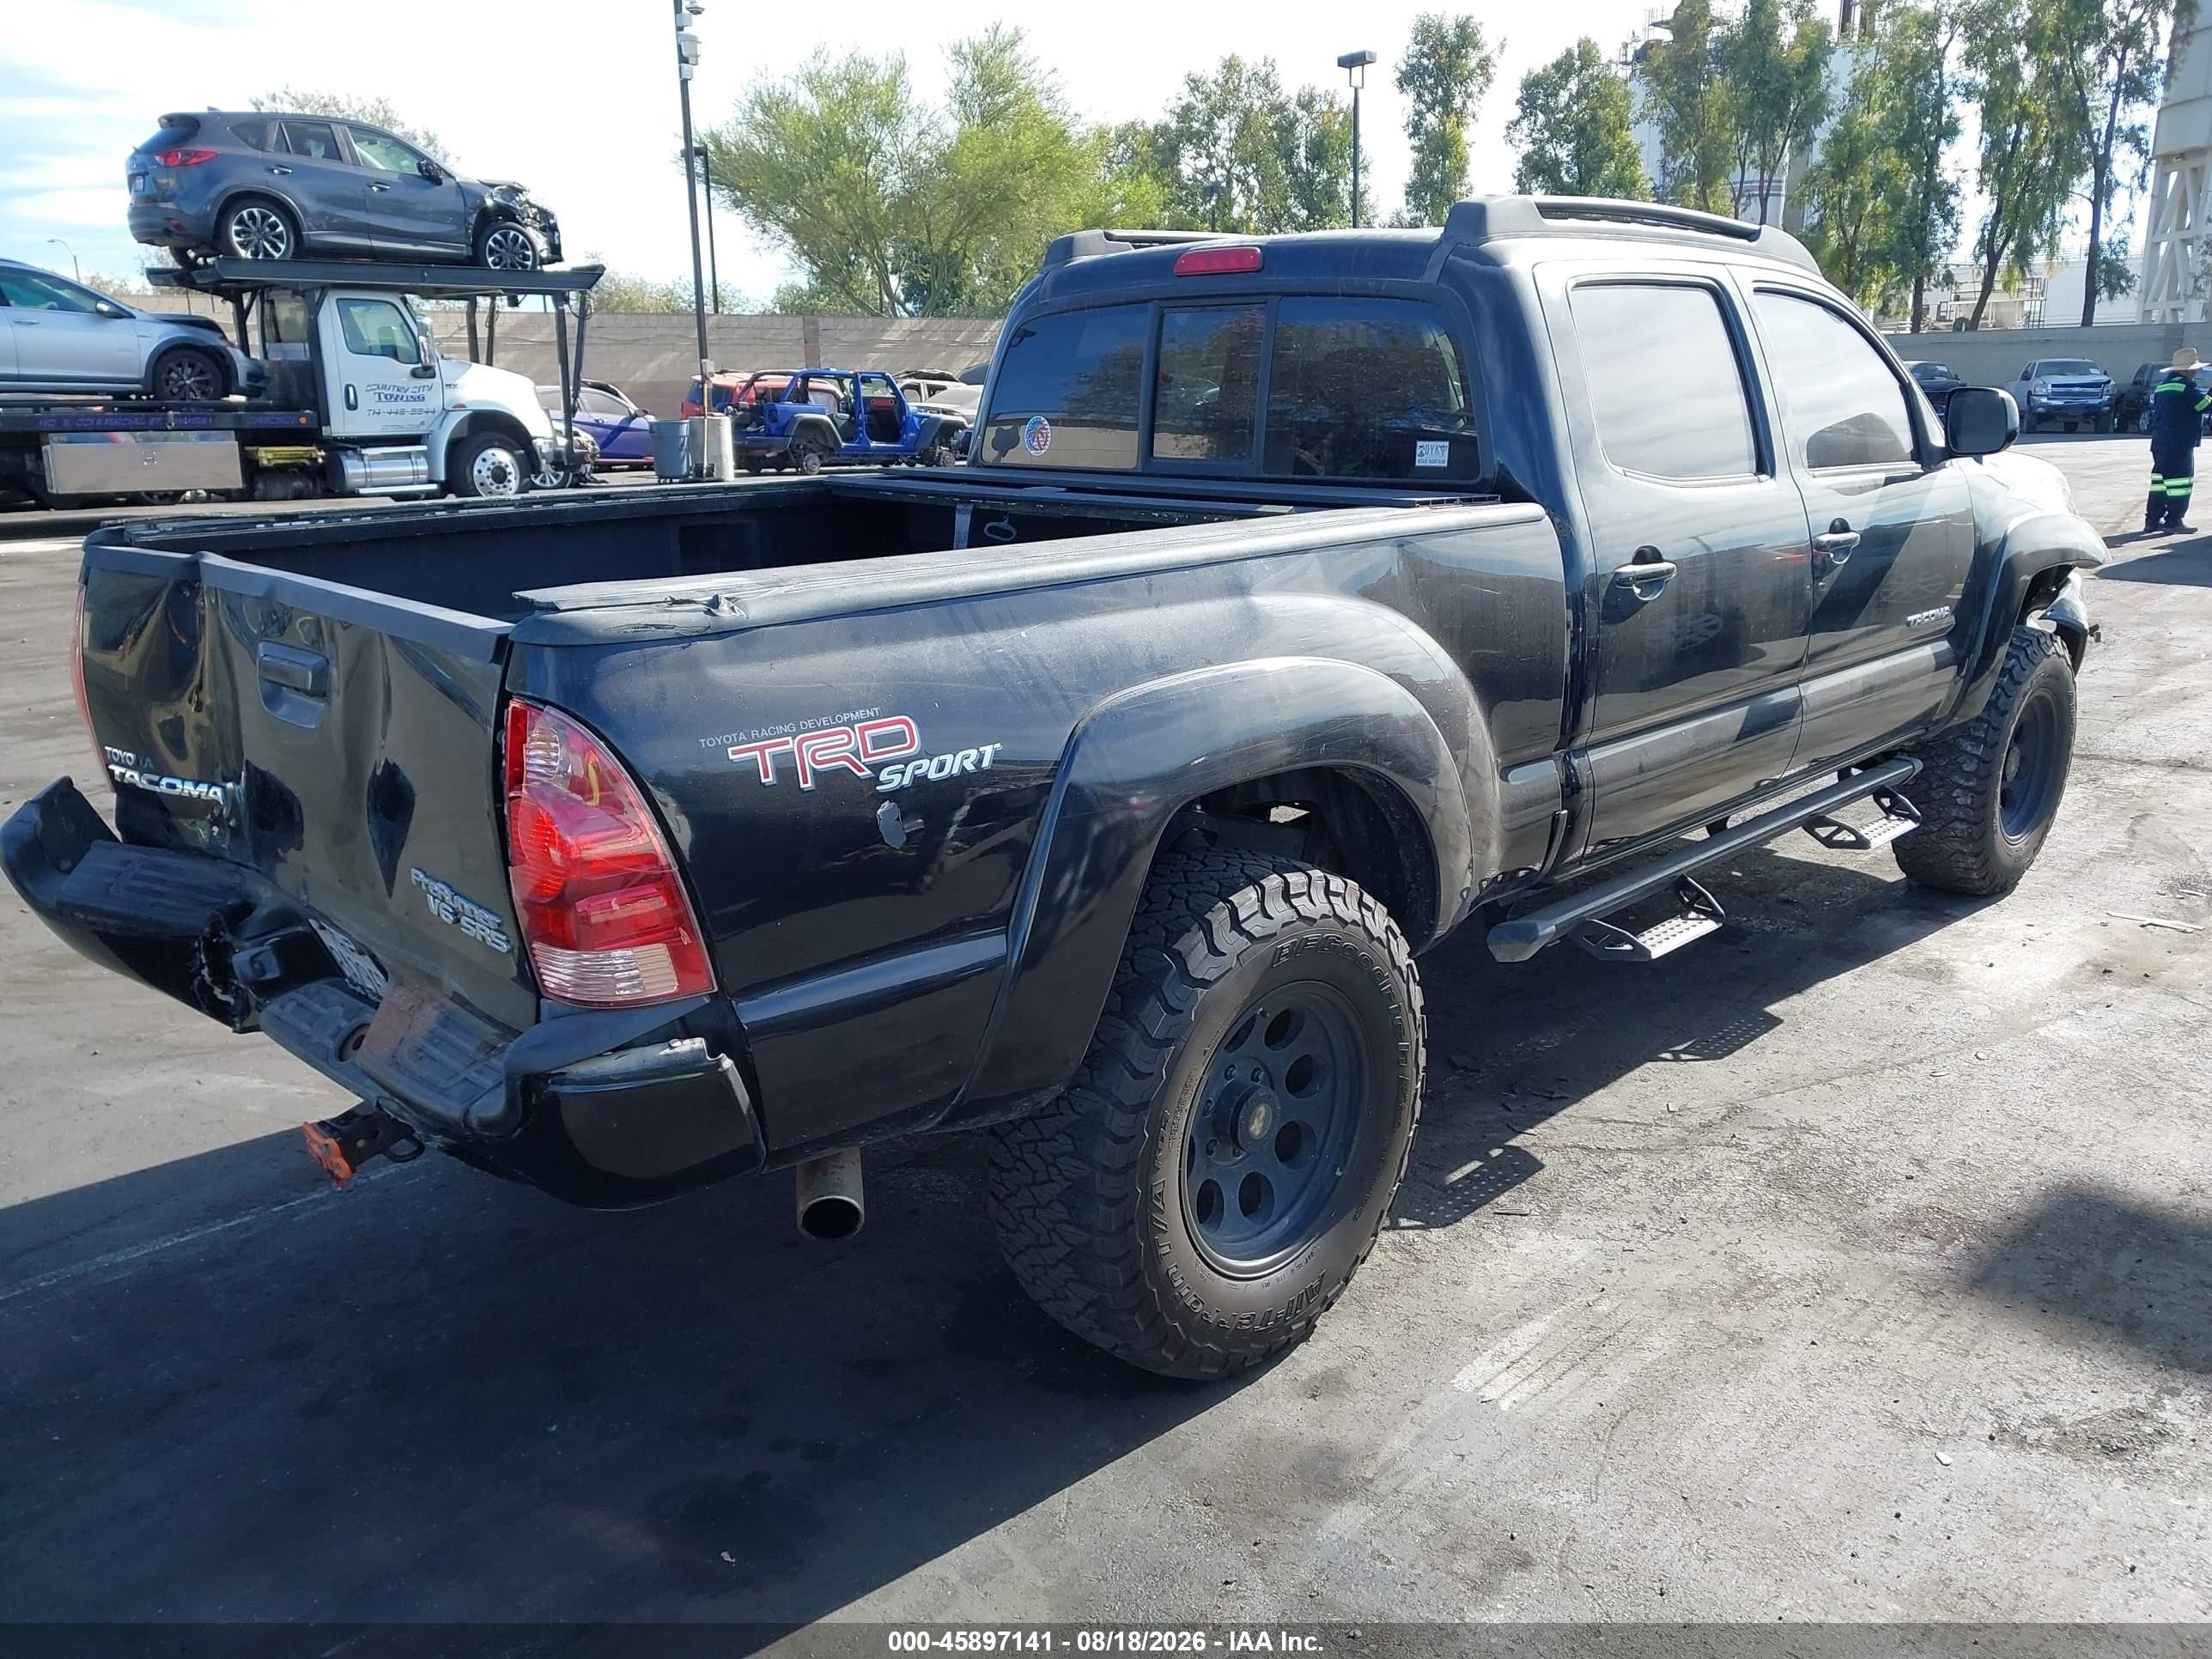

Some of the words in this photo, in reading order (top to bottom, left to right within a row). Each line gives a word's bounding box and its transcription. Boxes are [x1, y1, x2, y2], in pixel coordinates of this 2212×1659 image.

[365, 383, 410, 393] COUNTRY
[411, 383, 434, 393] CITY
[374, 392, 426, 402] TOWING
[1905, 605, 1951, 626] TACOMA
[699, 731, 747, 749] TOYOTA
[751, 723, 797, 738] RACING
[799, 707, 881, 731] DEVELOPMENT
[727, 714, 921, 792] TRD
[876, 742, 1003, 793] SPORT
[107, 763, 224, 805] TACOMA
[426, 893, 454, 925] V6
[1273, 933, 1411, 1067] BFGoodrich
